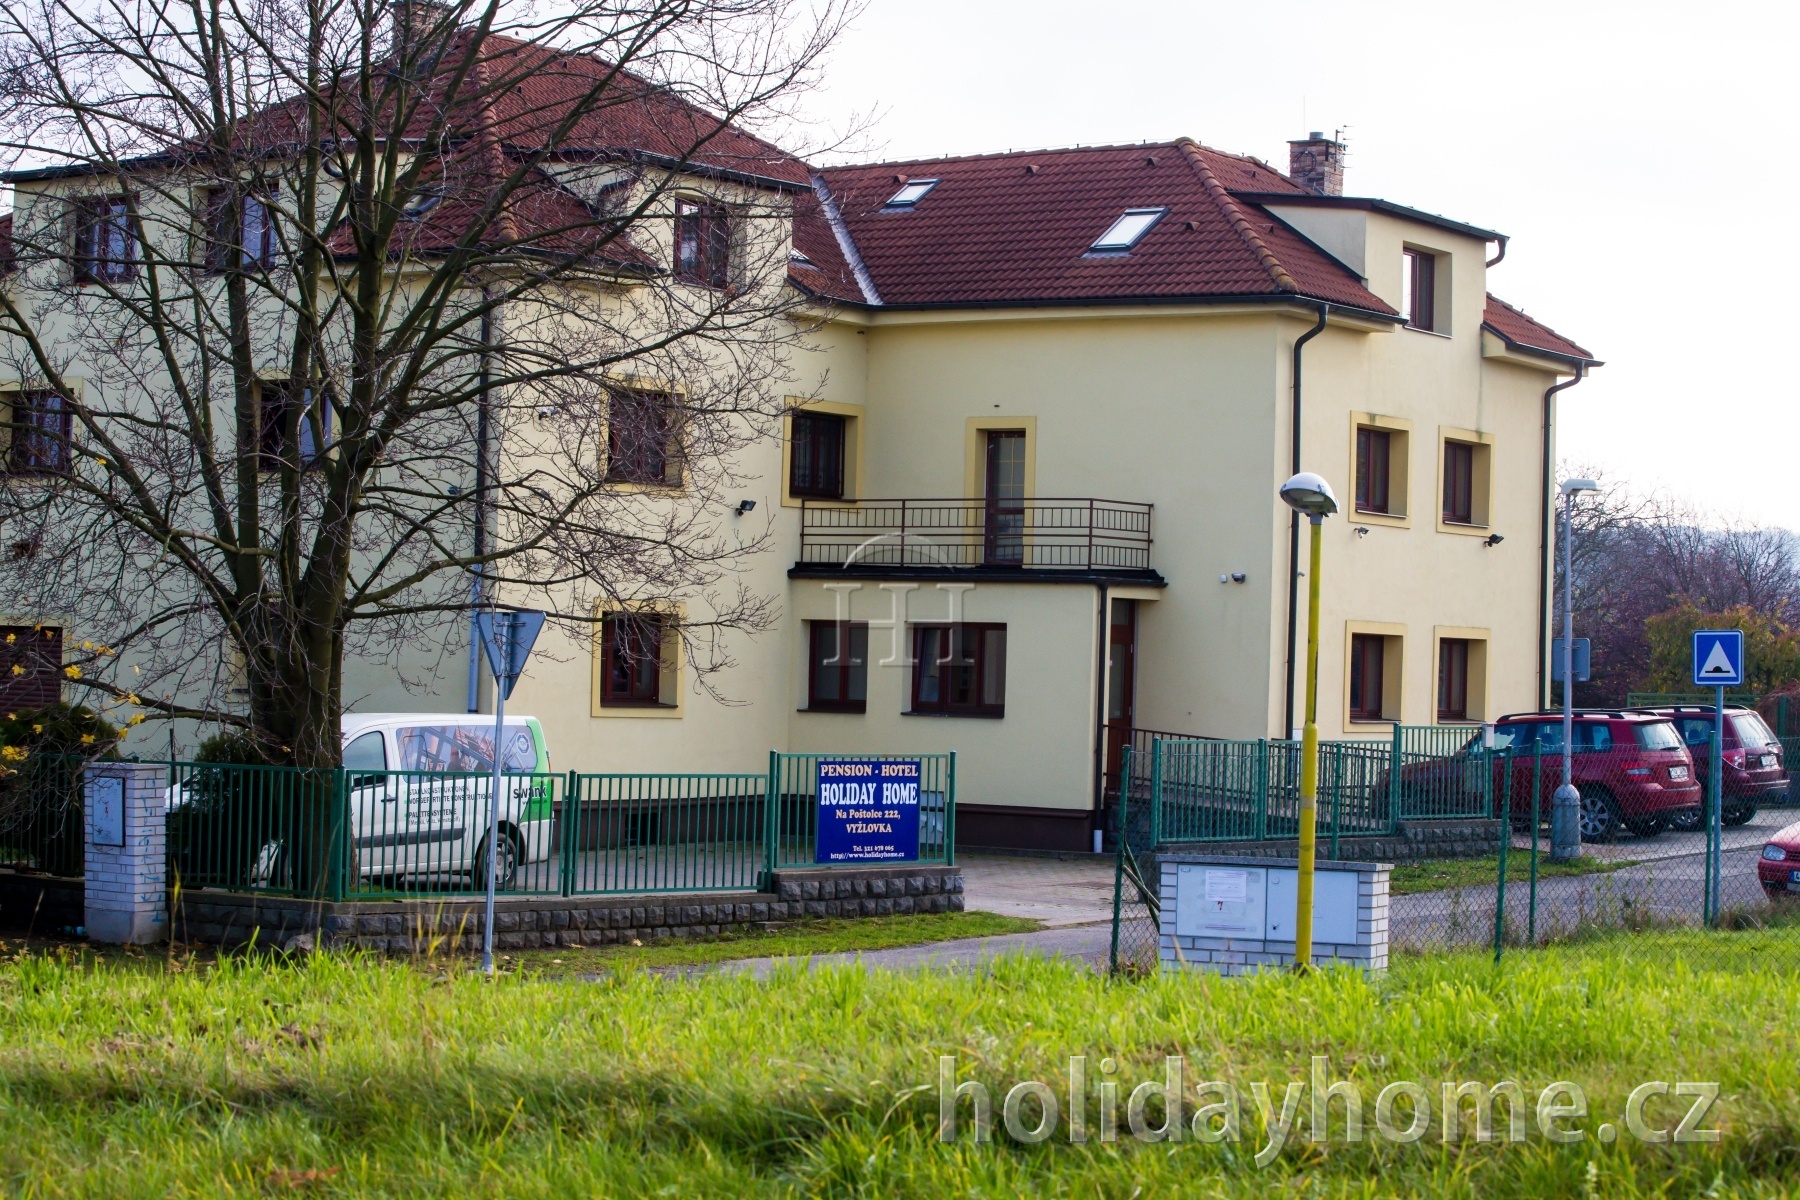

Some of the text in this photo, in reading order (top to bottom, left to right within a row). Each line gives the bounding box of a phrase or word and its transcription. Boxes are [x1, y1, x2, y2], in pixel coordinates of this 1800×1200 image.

[820, 764, 873, 777] PENSION
[881, 764, 918, 777] HOTEL
[820, 783, 918, 805] HOLIDAY HOME
[835, 808, 901, 820] Na Poštolce 222,
[846, 821, 893, 833] VYŽLOVKA
